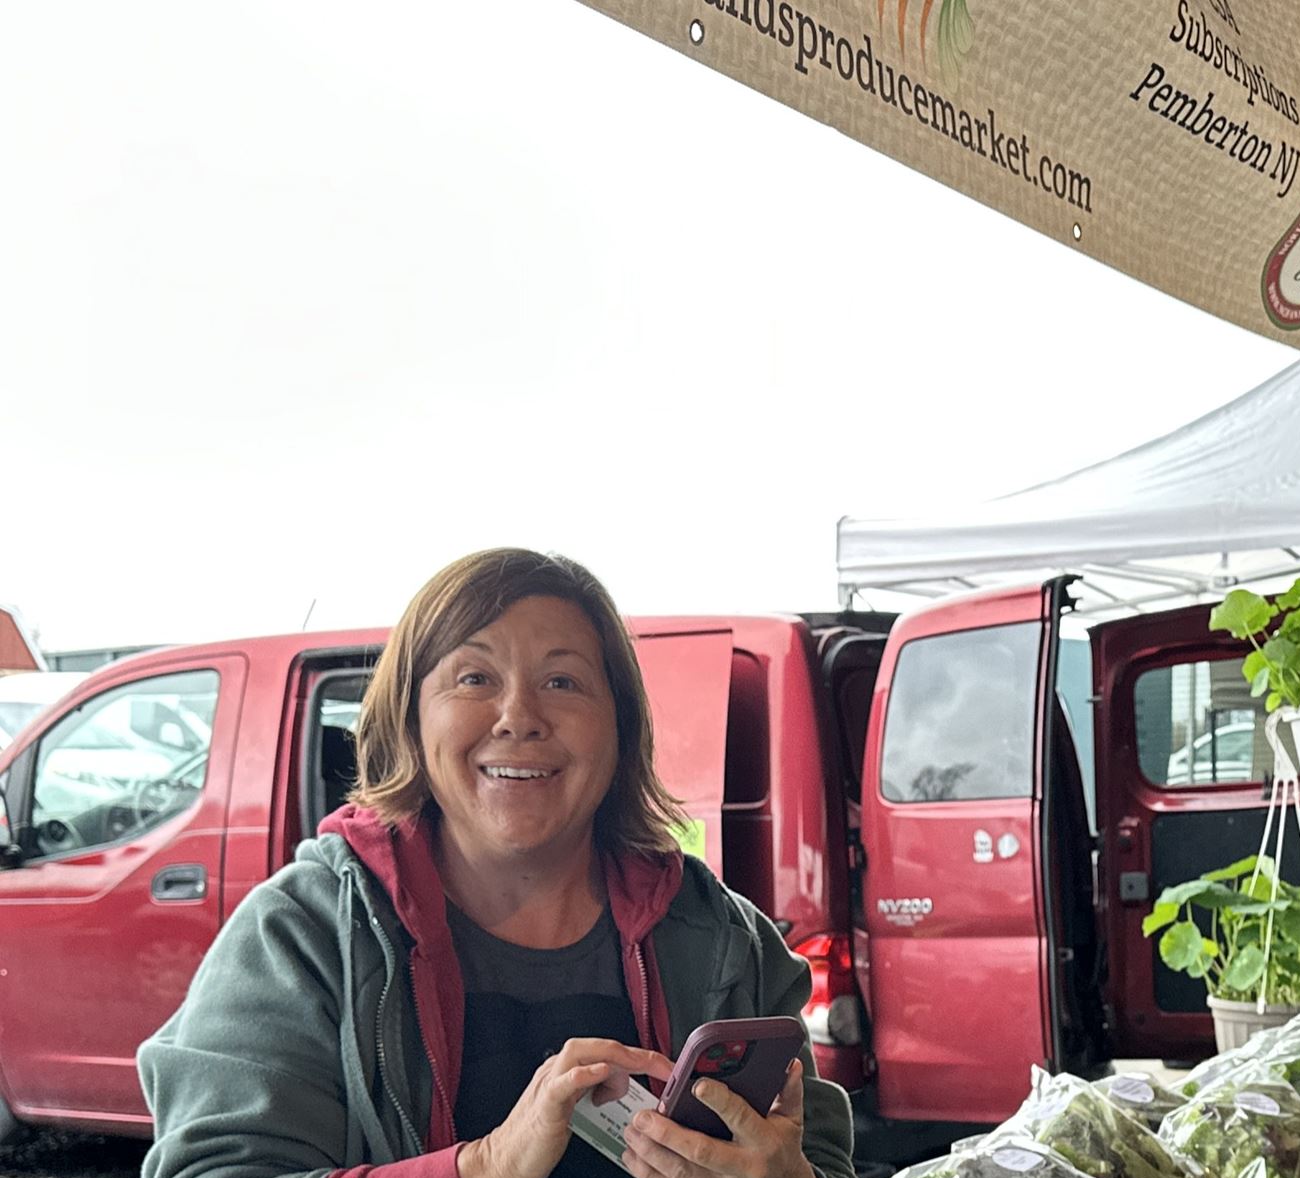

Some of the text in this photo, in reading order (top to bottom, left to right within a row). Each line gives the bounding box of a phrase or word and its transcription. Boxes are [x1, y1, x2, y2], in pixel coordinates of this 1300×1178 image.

[703, 0, 1093, 214] ndsproducemarket.com
[1129, 62, 1273, 174] Pemberton
[1169, 0, 1300, 126] Subscriptions
[877, 897, 934, 915] NV200
